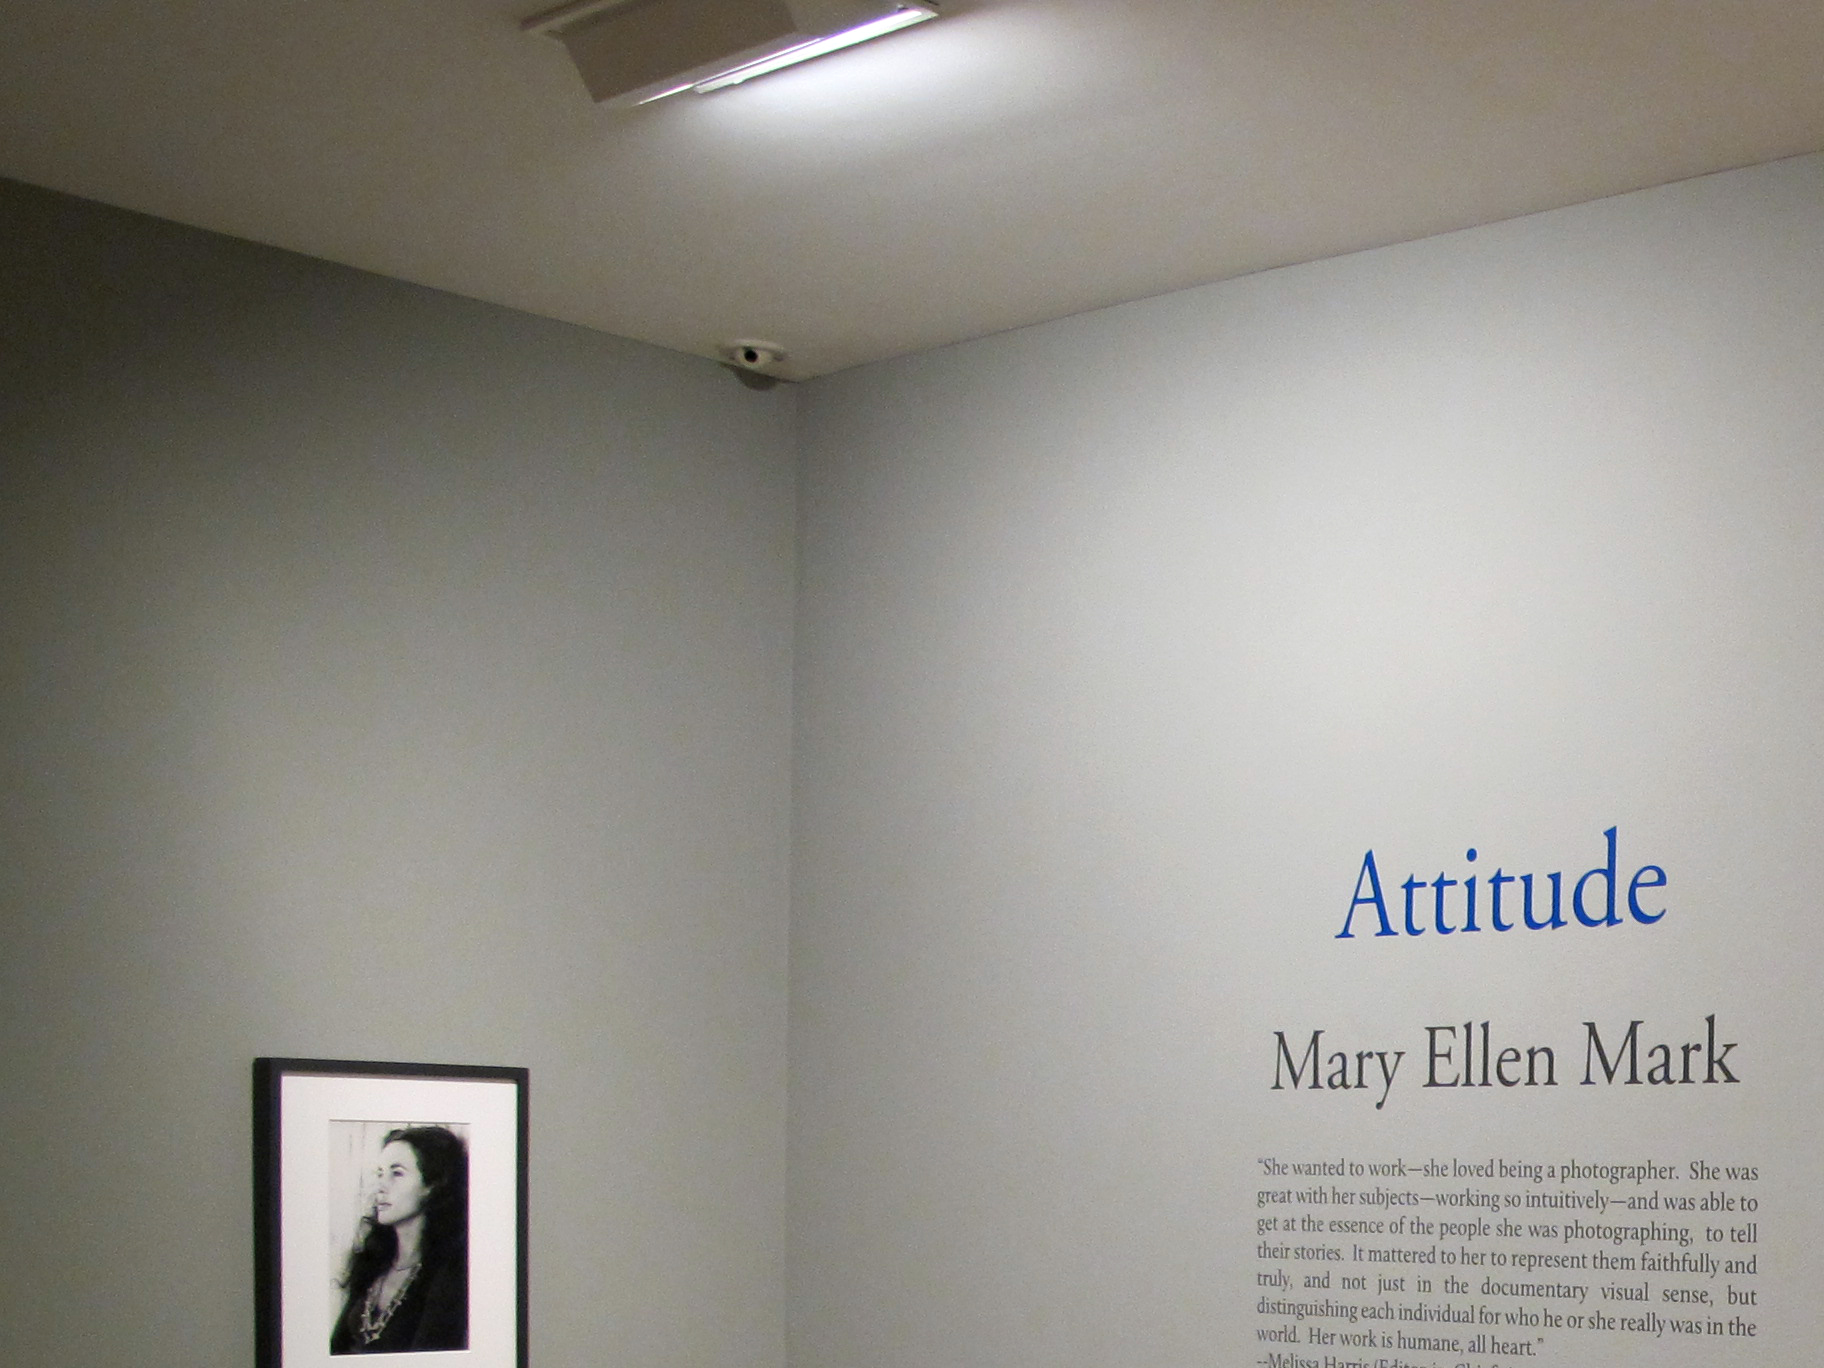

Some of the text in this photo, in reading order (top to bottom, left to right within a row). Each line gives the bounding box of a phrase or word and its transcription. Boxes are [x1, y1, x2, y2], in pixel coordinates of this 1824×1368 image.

[1334, 825, 1667, 939] Attitude
[1271, 1014, 1741, 1110] Mary Ellen Mark
[1293, 1158, 1344, 1176] wanted
[1350, 1161, 1364, 1176] to
[1454, 1158, 1494, 1177] loved
[1499, 1159, 1542, 1183] being
[1547, 1165, 1555, 1178] a
[1561, 1159, 1679, 1185] photographer.
[1690, 1160, 1720, 1180] She
[1726, 1167, 1759, 1180] was
[1257, 1189, 1292, 1208] great
[1296, 1186, 1328, 1203] with
[1332, 1186, 1355, 1204] her
[1505, 1195, 1521, 1207] so
[1664, 1197, 1695, 1210] was
[1700, 1191, 1735, 1211] able
[1740, 1196, 1758, 1212] to
[1257, 1214, 1757, 1247] get at the essence of the people she was photographing, to tell
[1258, 1241, 1757, 1278] their stories. It mattered to her to represent them faithfully and
[1258, 1269, 1757, 1306] truly, and not just in the documentary visual sense, but
[1257, 1296, 1756, 1338] distinguishing each individual for who he or she really was in the
[1257, 1325, 1300, 1343] world.
[1309, 1327, 1336, 1345] Her
[1340, 1329, 1376, 1347] work
[1382, 1332, 1393, 1348] is
[1398, 1330, 1463, 1353] humane,
[1468, 1335, 1486, 1353] all
